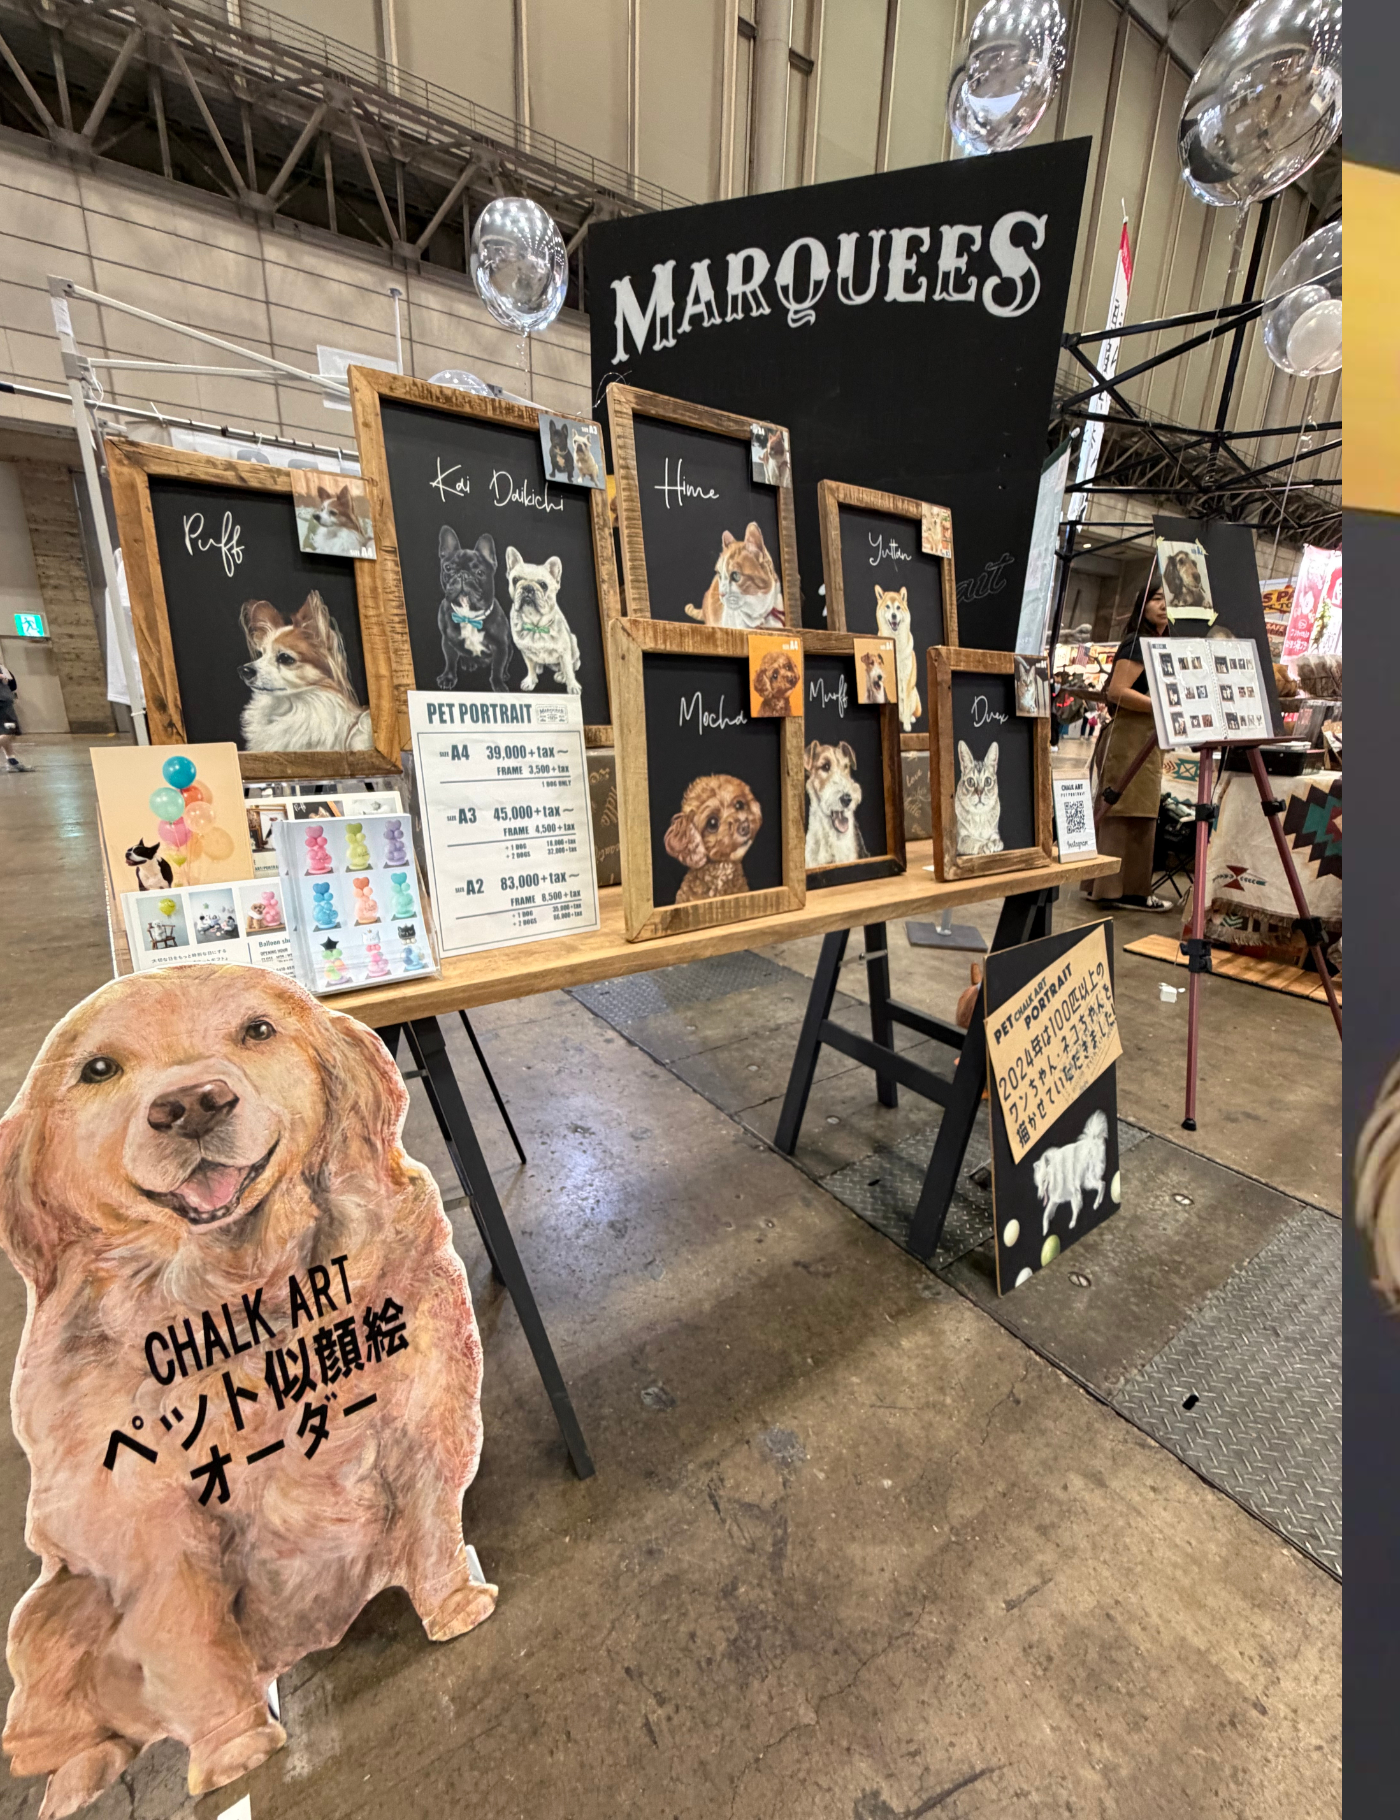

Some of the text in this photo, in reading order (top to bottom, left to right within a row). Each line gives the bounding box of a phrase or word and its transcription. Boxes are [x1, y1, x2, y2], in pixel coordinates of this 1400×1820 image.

[609, 210, 1049, 366] MARQUEES
[430, 457, 565, 513] Kai Daikichi
[654, 457, 720, 509] Hime
[183, 511, 246, 578] Puff
[426, 702, 533, 725] PET PORTRAIT
[679, 692, 748, 735] Mocha
[451, 744, 470, 761] A4
[497, 765, 523, 776] FRAME
[458, 807, 477, 825] A3
[503, 826, 530, 837] FRAME
[1067, 840, 1089, 850] Instagram
[466, 878, 485, 896] A2
[510, 895, 536, 907] FRAME
[259, 939, 280, 948] Balloon
[993, 977, 1048, 1045] PET CHALK ART
[1024, 962, 1073, 1030] PORTRAIT
[999, 962, 1105, 1102] 2024年は100匹以上の
[144, 1254, 353, 1386] CHALK ART
[103, 1297, 409, 1472] ペット似顔絵
[189, 1391, 378, 1507] オーダー
